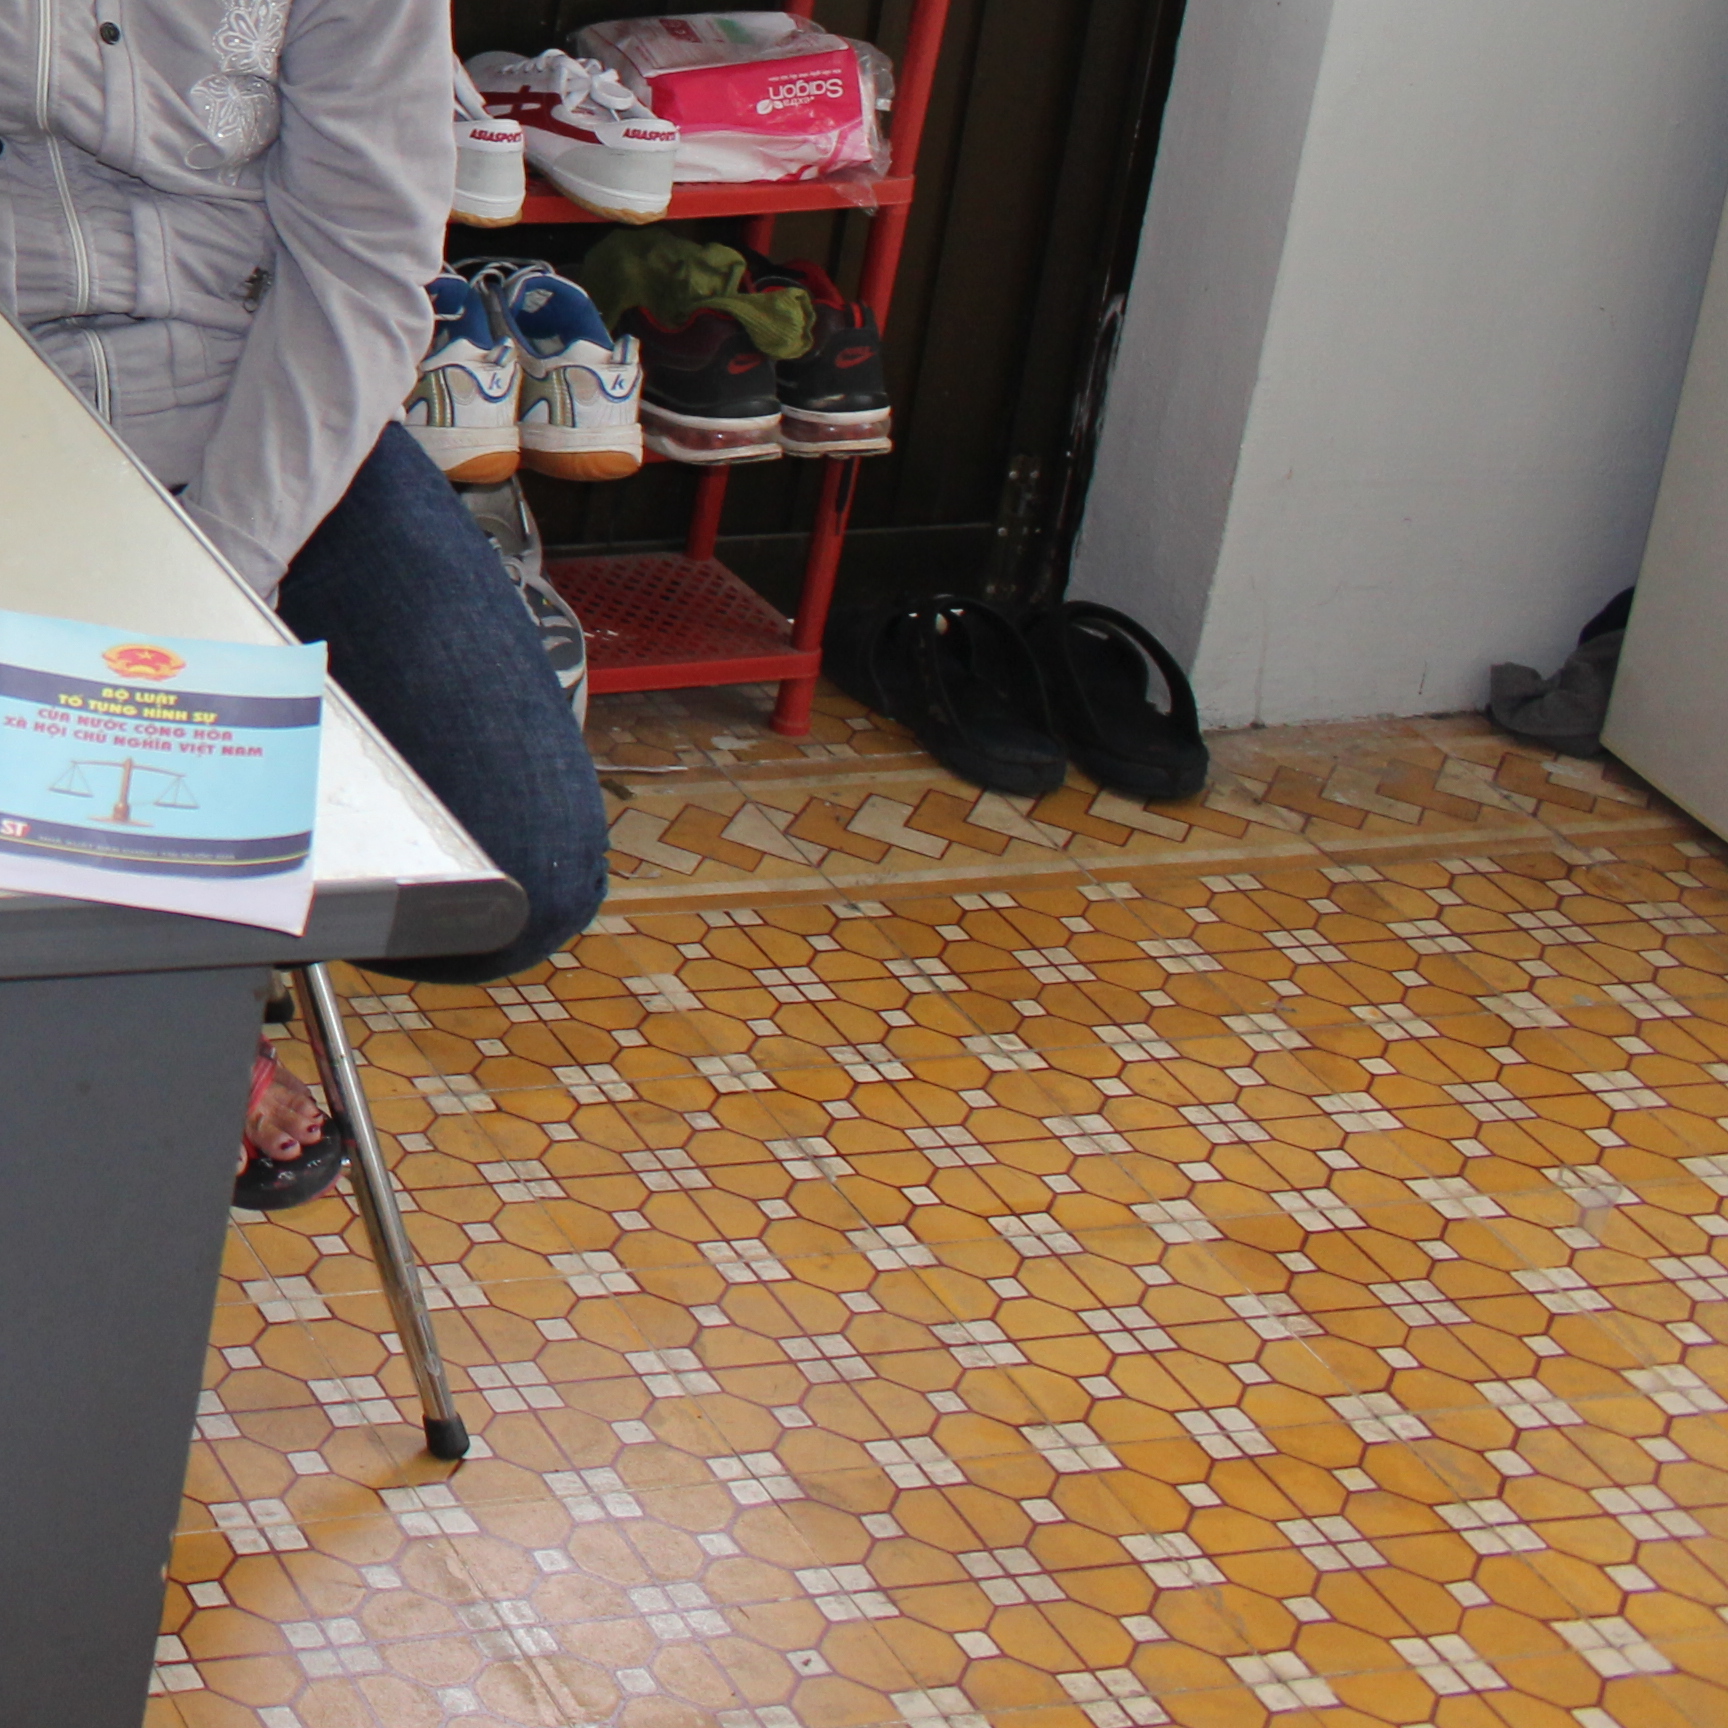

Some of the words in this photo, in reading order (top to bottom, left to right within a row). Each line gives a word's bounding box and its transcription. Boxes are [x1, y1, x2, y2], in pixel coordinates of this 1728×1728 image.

[768, 78, 843, 100] Saigon
[58, 690, 83, 708] TỐ
[88, 699, 138, 717] TỤNG
[143, 702, 188, 722] HÌNH
[192, 710, 219, 724] SỰ
[102, 687, 129, 703] BỘ
[134, 690, 178, 707] LUẬT
[3, 714, 27, 729] XÃ
[34, 722, 66, 739] HỘI
[73, 727, 108, 744] CHỦ
[113, 734, 173, 752] NGHĨA
[179, 741, 215, 757] VIỆT
[221, 746, 263, 757] NAM
[38, 706, 71, 723] CỦA
[77, 714, 127, 732] NƯỚC
[134, 722, 186, 739] CỘNG
[0, 819, 31, 839] ST
